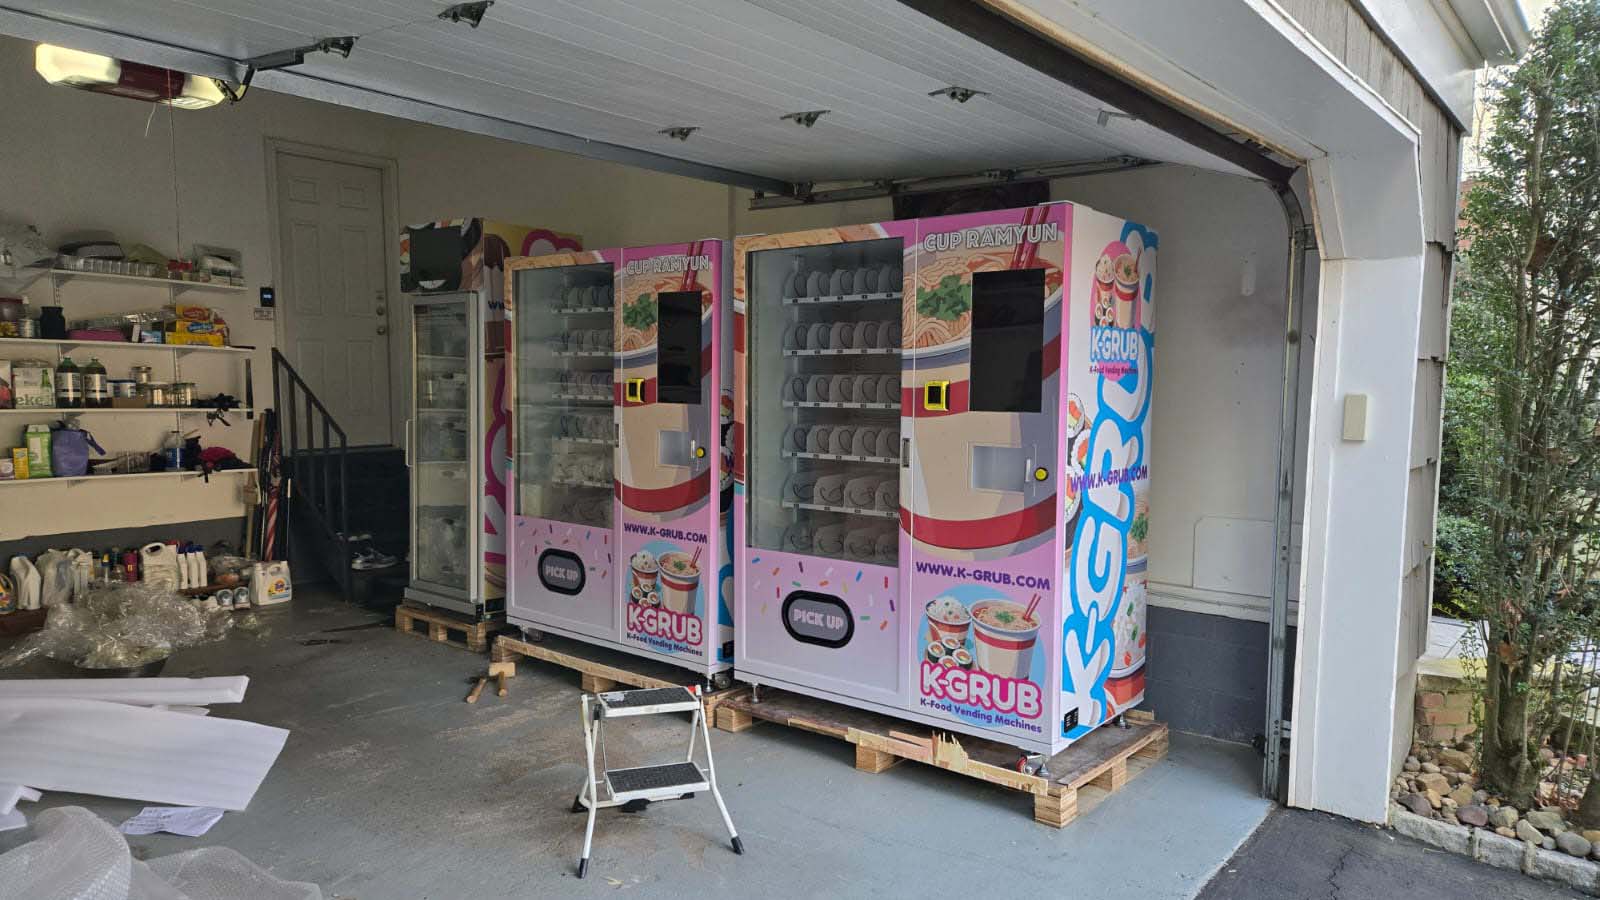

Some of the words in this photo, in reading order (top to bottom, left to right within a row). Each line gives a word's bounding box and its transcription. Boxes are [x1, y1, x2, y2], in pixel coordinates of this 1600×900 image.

[924, 231, 961, 252] CUP
[966, 222, 1057, 249] RAMYUN
[626, 260, 650, 275] CUP
[653, 255, 710, 273] RAMYUN
[1090, 326, 1138, 362] K-GRUB
[1071, 465, 1148, 493] WWW.K-GRUB.COM
[624, 522, 708, 544] WWW.K-GRUB.COM
[545, 565, 566, 579] PICK
[916, 561, 1051, 591] WWW.K-GRUB.COM
[627, 602, 703, 646] K-GRUB
[793, 608, 824, 627] PICK
[826, 615, 844, 630] UP
[626, 632, 648, 641] K-Food
[648, 635, 673, 651] Vending
[673, 642, 703, 657] Machines
[920, 660, 1042, 719] K-GRUB
[920, 699, 952, 712] K-Food
[954, 705, 993, 724] Vending
[994, 714, 1042, 734] Machines
